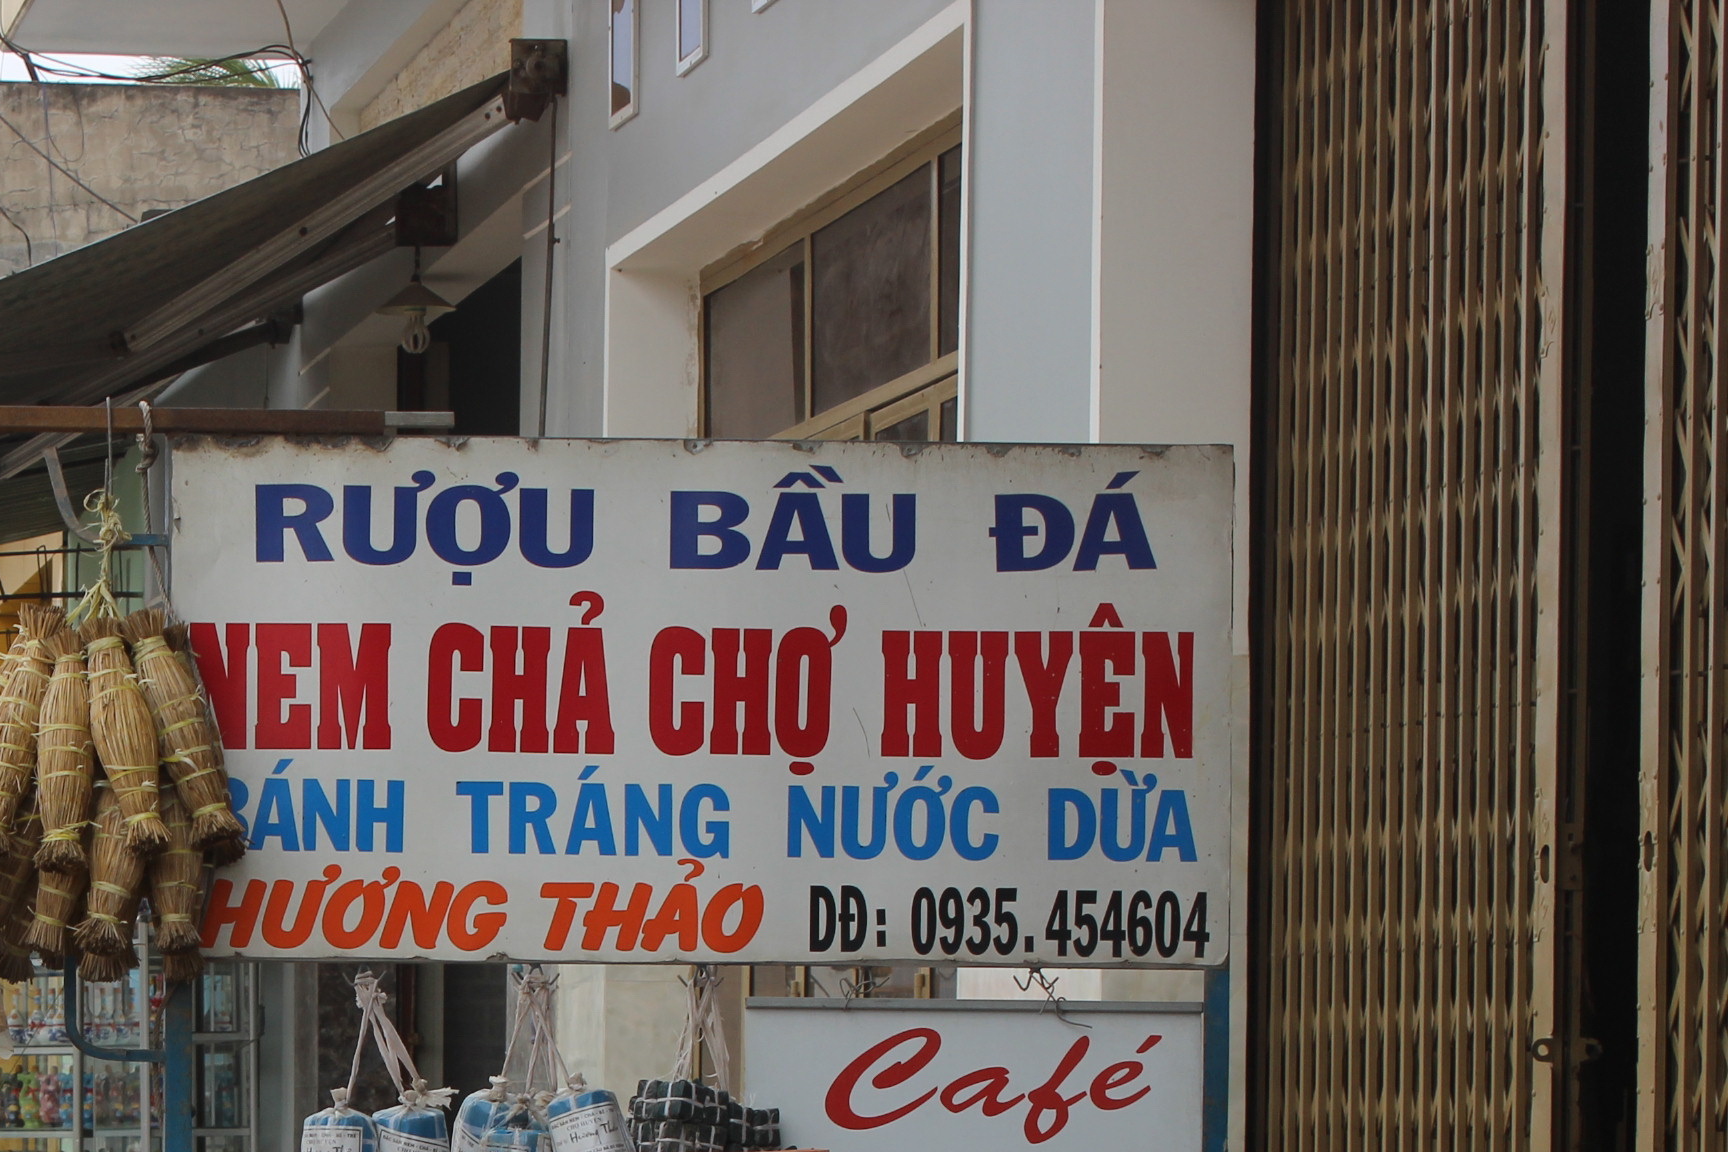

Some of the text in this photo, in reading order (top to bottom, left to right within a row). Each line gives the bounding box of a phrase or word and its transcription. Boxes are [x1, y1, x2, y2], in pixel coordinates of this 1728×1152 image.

[255, 465, 1157, 586] RƯỢU BẦU ĐÁ
[189, 590, 1194, 776] NEM CHẢ CHỢ HUYỆN
[456, 765, 730, 859] TRÁNG
[787, 765, 999, 861] NƯỚC
[1048, 769, 1197, 862] DỪA
[200, 864, 508, 952] HƯƠNG
[540, 859, 764, 953] THẢO
[911, 887, 1209, 958] 0935.454604
[824, 1027, 1162, 1144] Café
